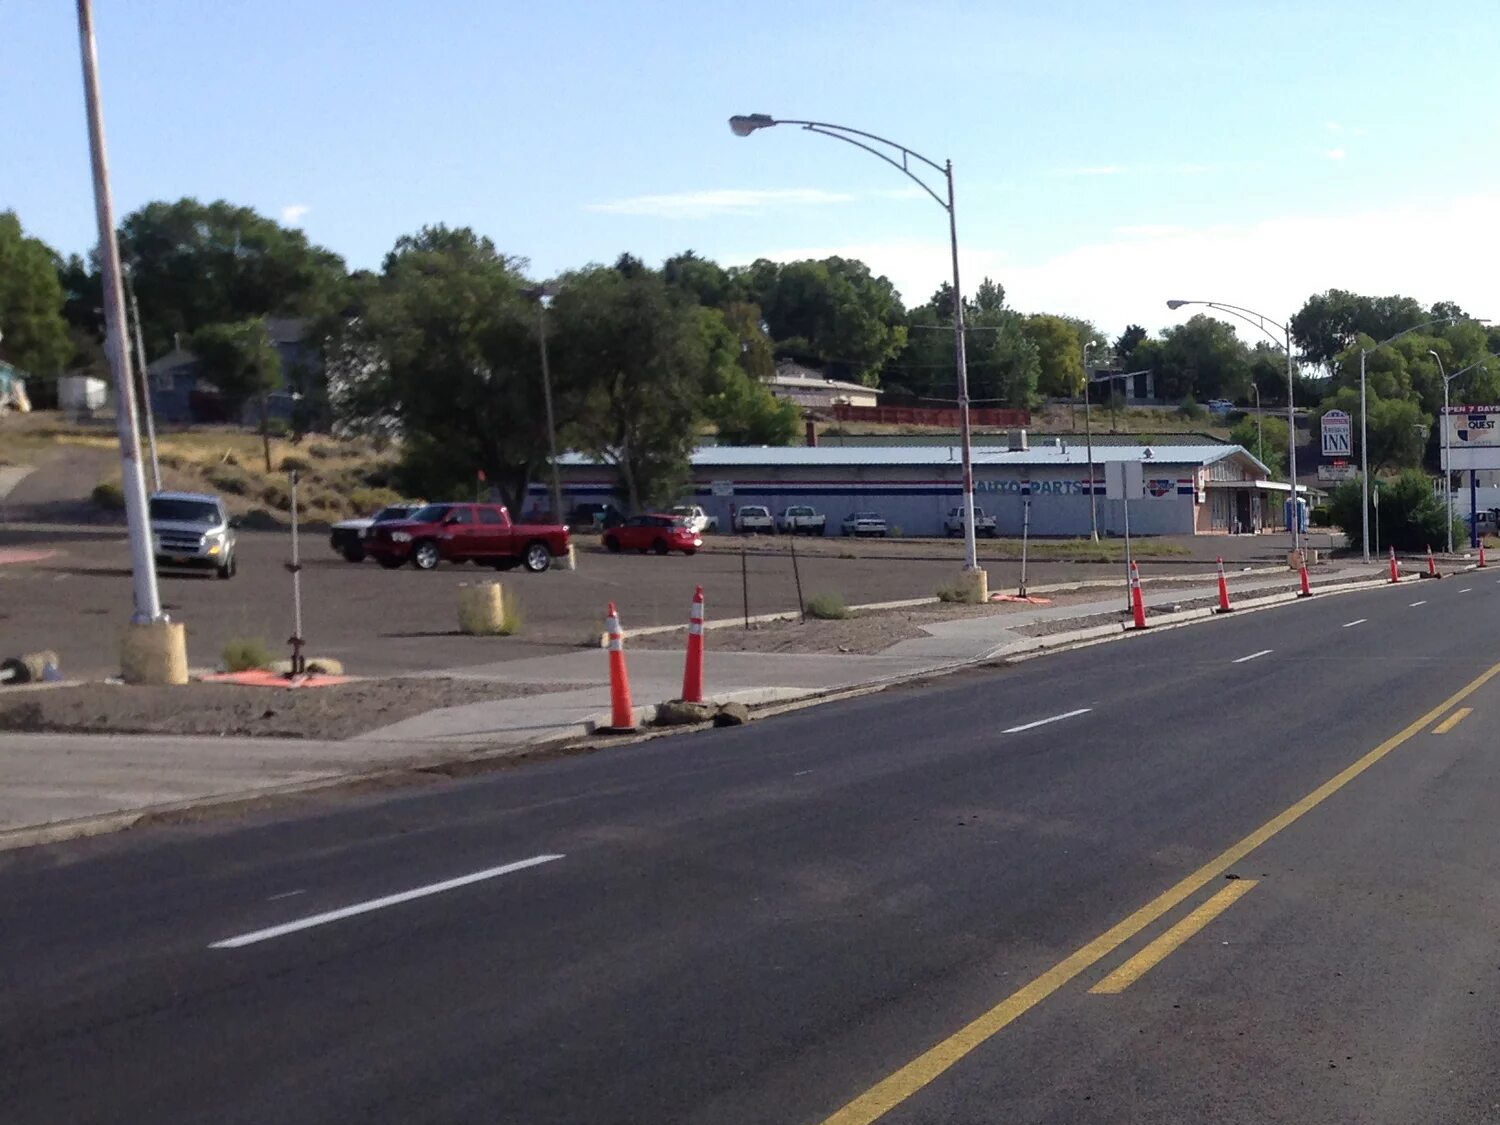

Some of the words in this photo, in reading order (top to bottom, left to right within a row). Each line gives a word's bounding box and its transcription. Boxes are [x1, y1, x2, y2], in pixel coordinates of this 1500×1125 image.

[1323, 434, 1348, 451] INN
[976, 480, 1020, 495] AUTO
[1030, 480, 1082, 495] PARTS
